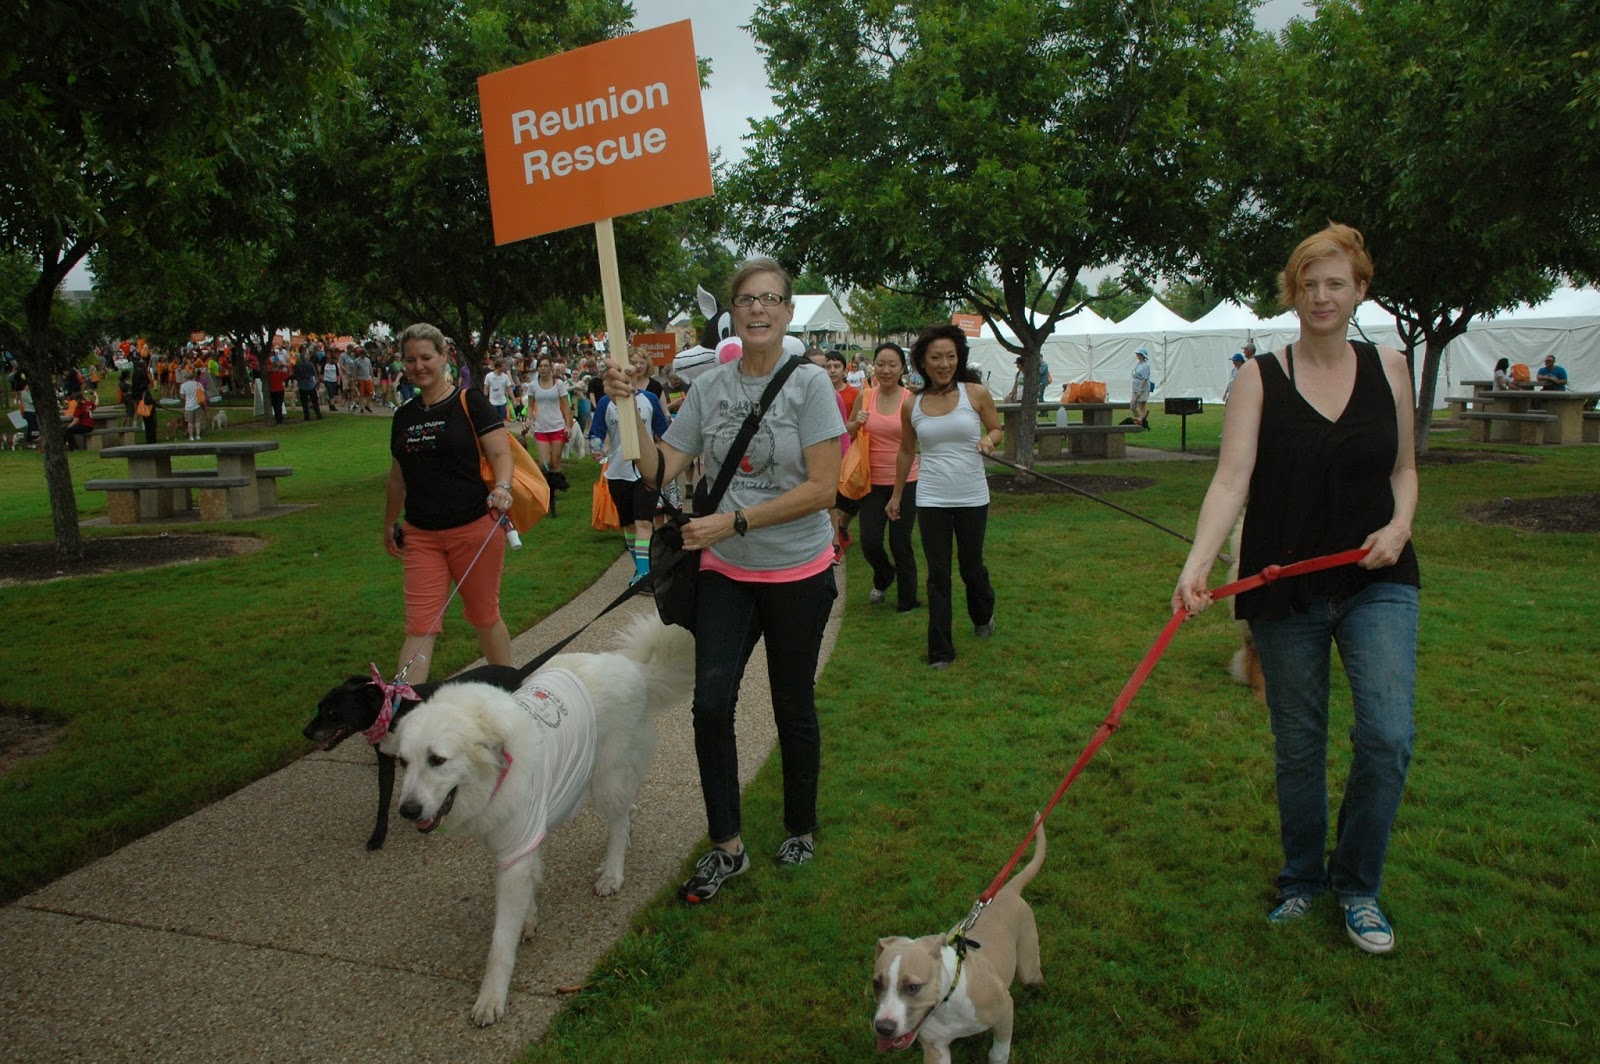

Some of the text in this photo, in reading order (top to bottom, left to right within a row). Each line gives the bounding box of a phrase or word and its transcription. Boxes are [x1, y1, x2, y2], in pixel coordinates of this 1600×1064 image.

[511, 81, 669, 145] Reunion
[522, 127, 667, 185] Rescue
[640, 342, 671, 350] Shadow
[731, 479, 780, 492] escue
